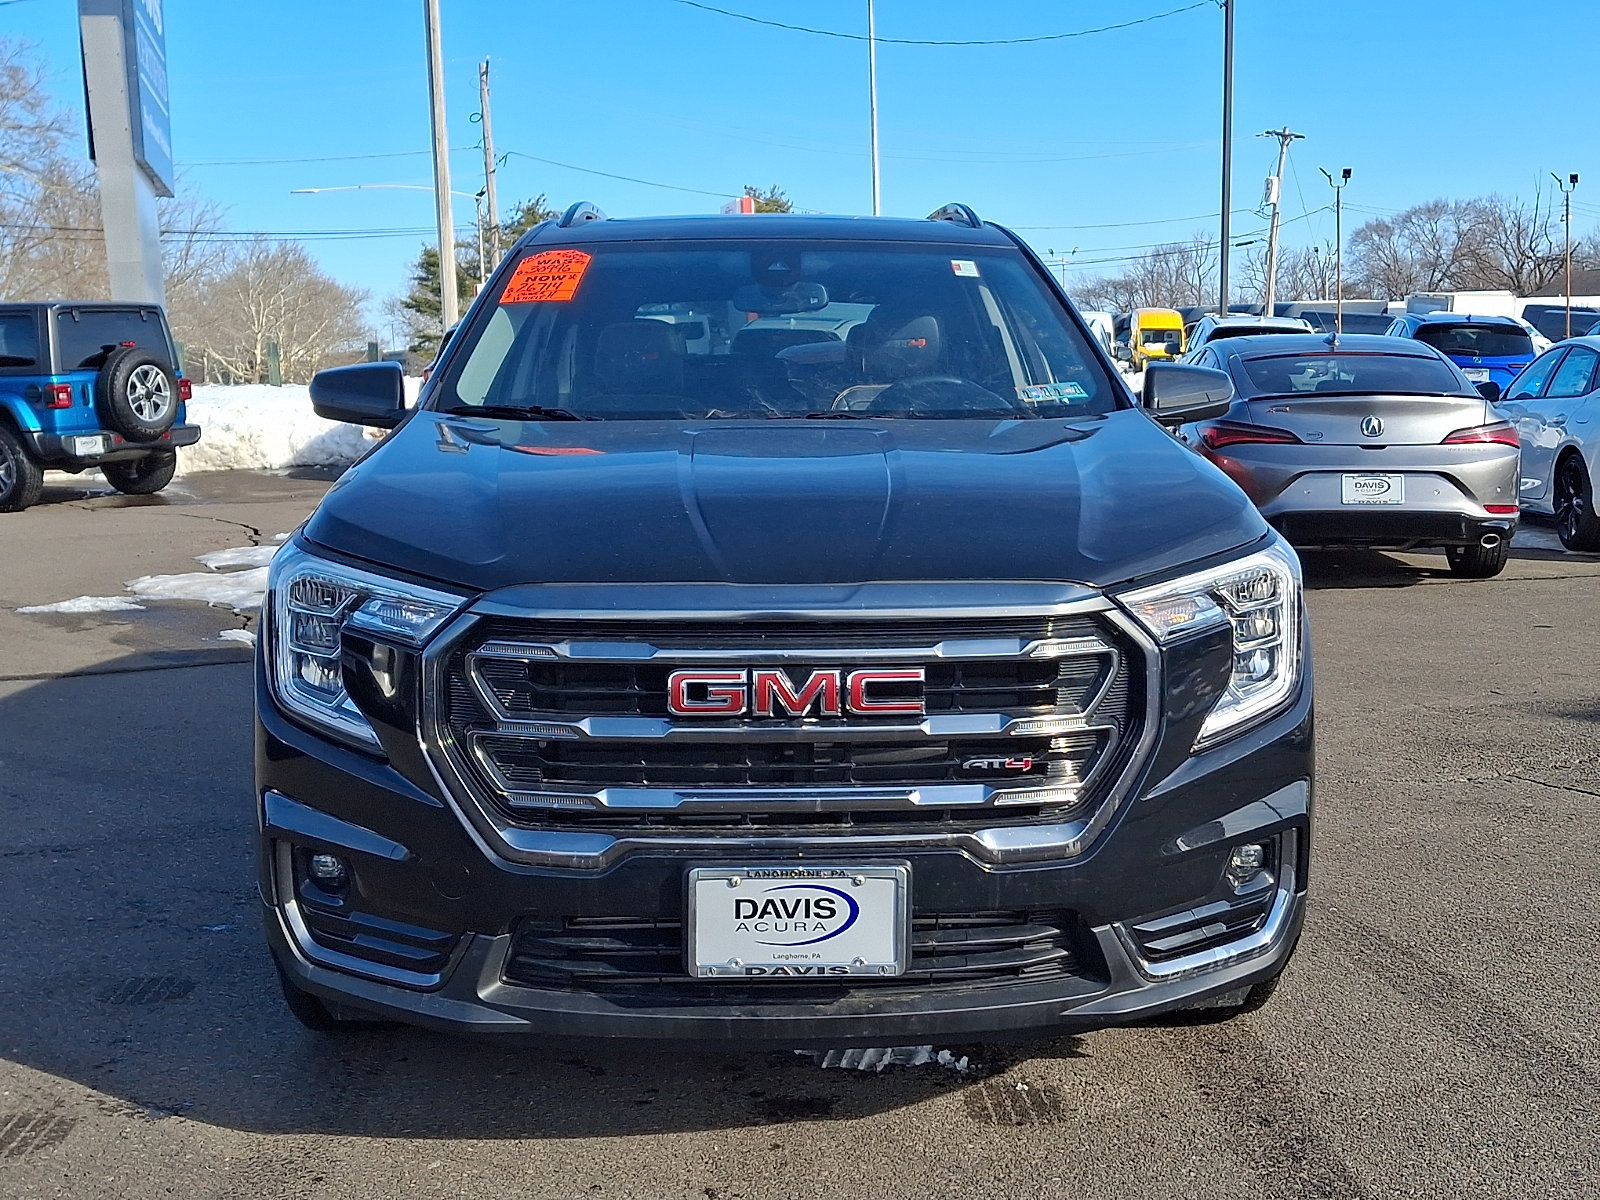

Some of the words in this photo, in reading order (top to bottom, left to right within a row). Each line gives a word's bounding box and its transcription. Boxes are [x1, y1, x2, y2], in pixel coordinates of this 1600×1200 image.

[525, 274, 567, 282] NOW
[1354, 481, 1385, 489] DAVIS
[667, 667, 926, 717] GMC
[962, 757, 1032, 772] AT4
[734, 897, 837, 920] DAVIS
[735, 921, 828, 933] ACURA
[744, 965, 850, 976] DAVIS
